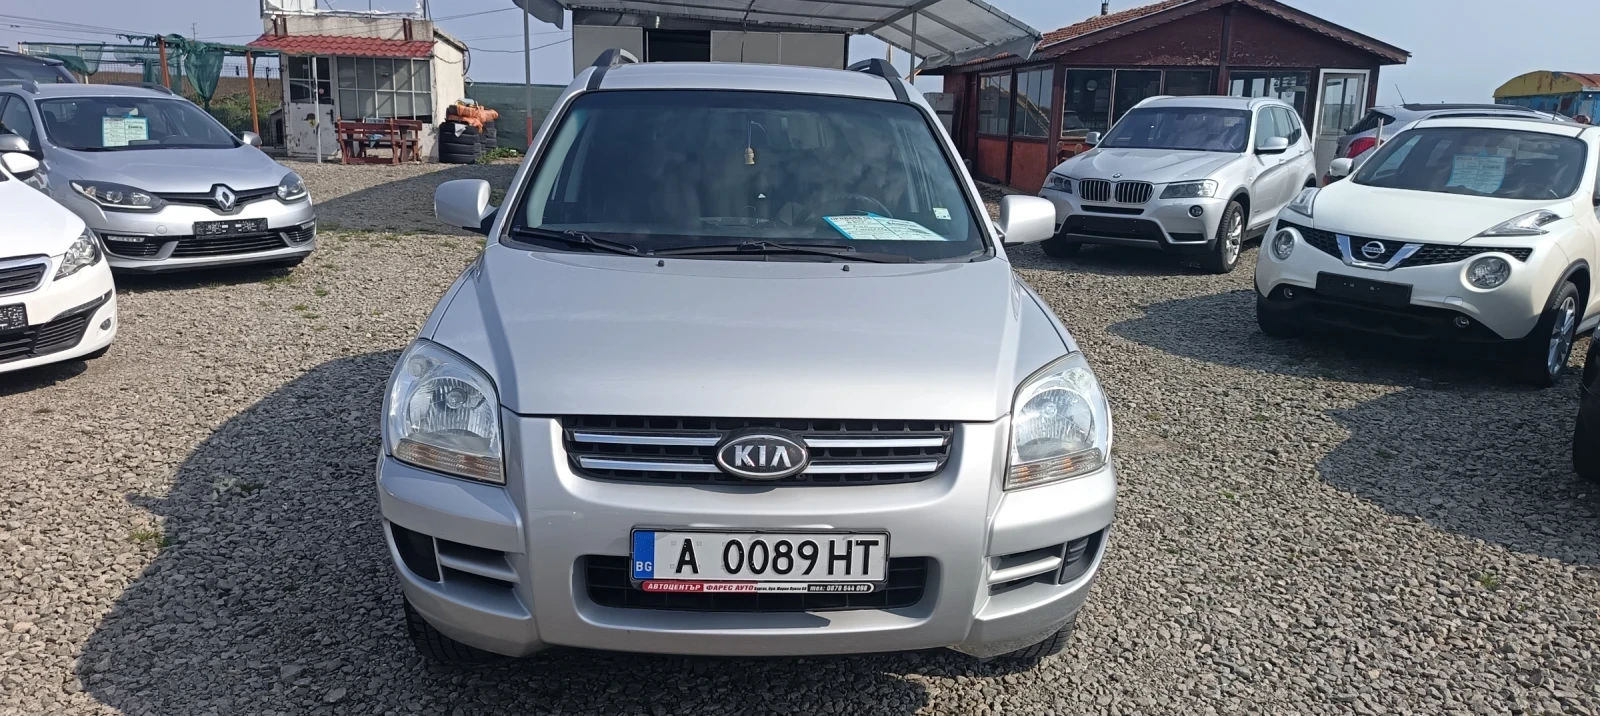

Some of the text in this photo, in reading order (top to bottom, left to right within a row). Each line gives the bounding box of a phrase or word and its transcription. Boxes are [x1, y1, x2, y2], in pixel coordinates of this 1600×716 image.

[733, 445, 792, 467] KIA
[675, 538, 699, 574] A
[635, 560, 653, 572] BG
[647, 583, 701, 591] АВТОЦЕНТЪР
[706, 583, 733, 591] ФАРЕС
[734, 583, 754, 591] АУТО
